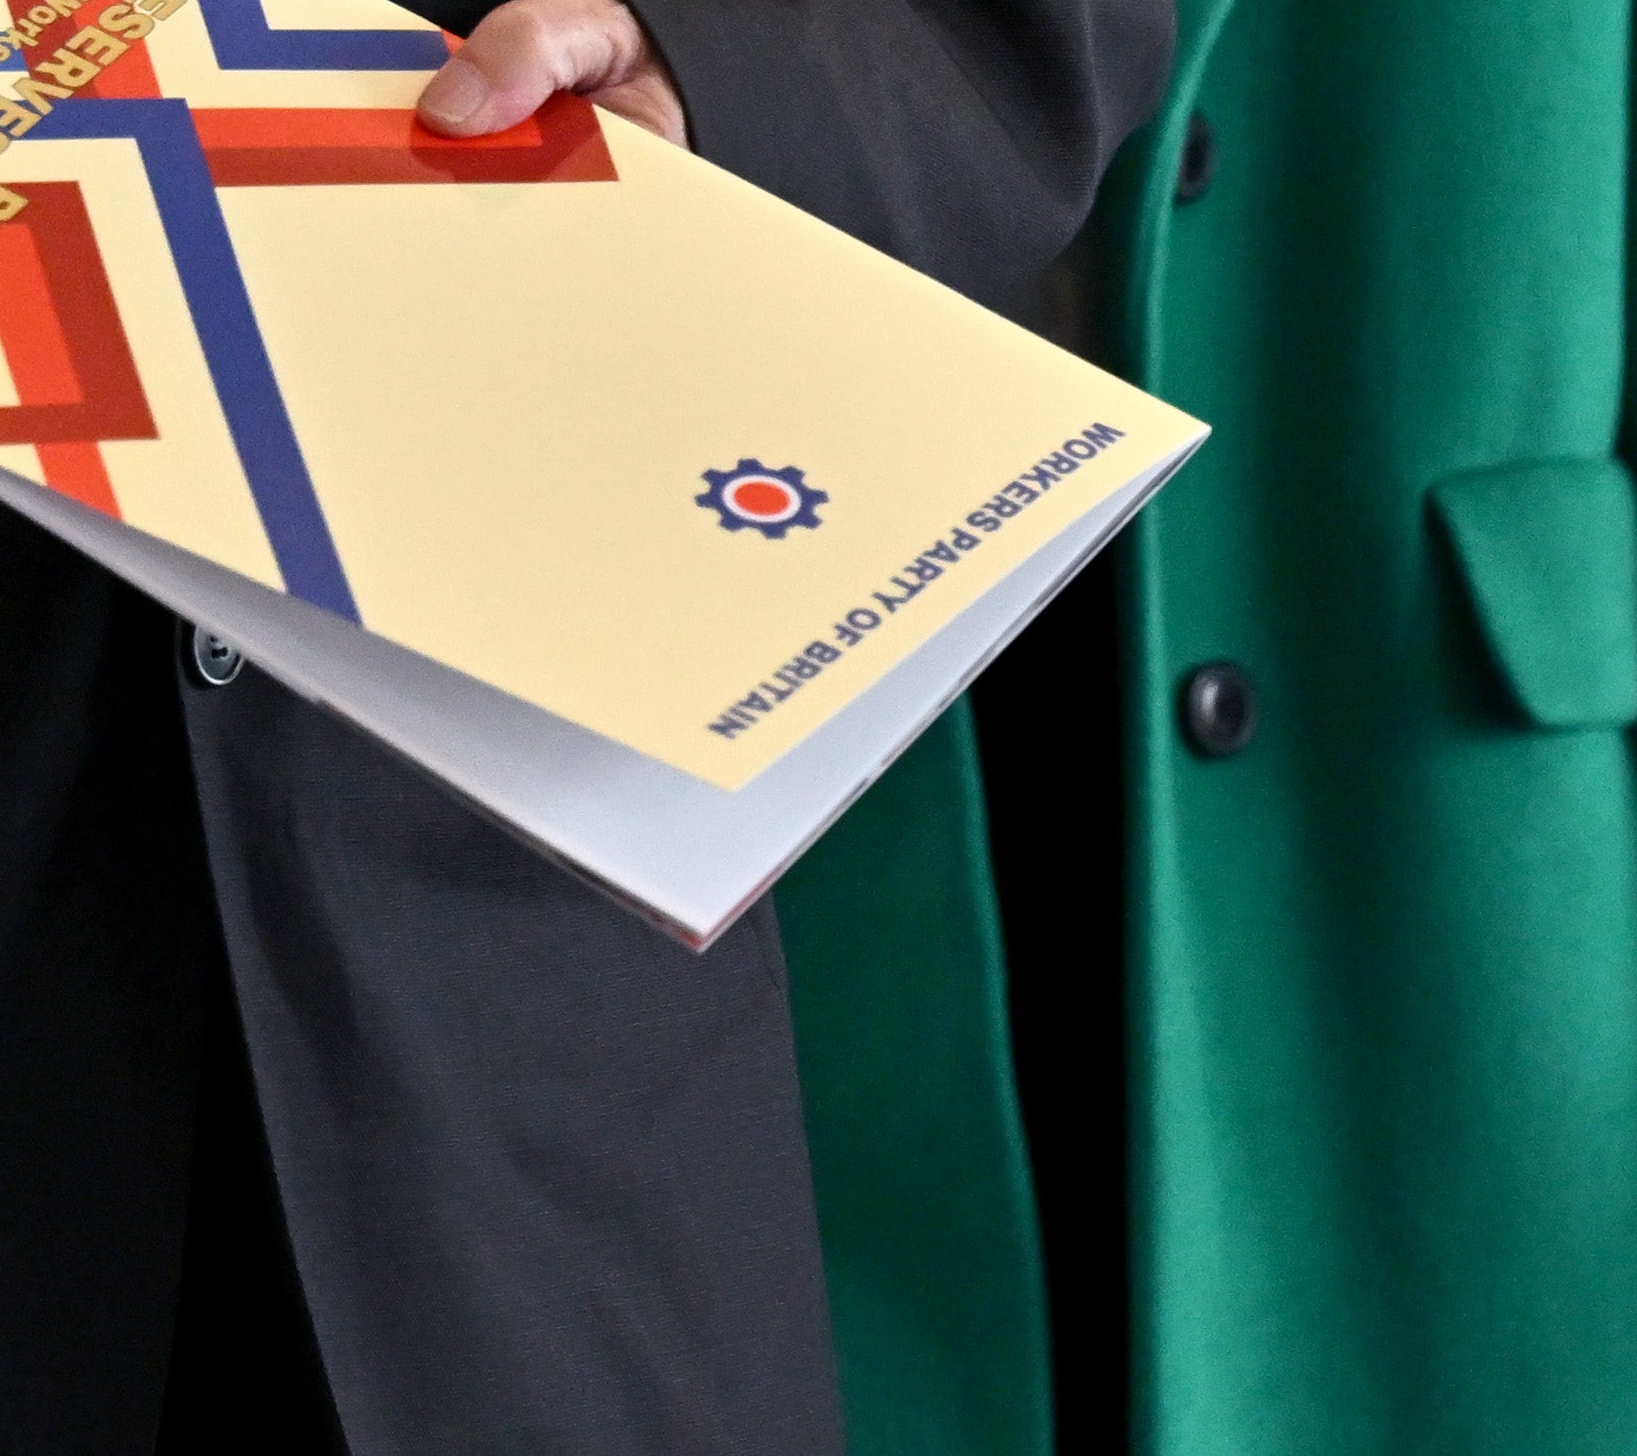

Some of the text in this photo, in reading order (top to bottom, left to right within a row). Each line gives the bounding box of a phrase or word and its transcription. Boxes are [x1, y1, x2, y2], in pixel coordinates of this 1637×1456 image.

[707, 422, 1127, 739] WORKERS PARTY OF BRITAIN
